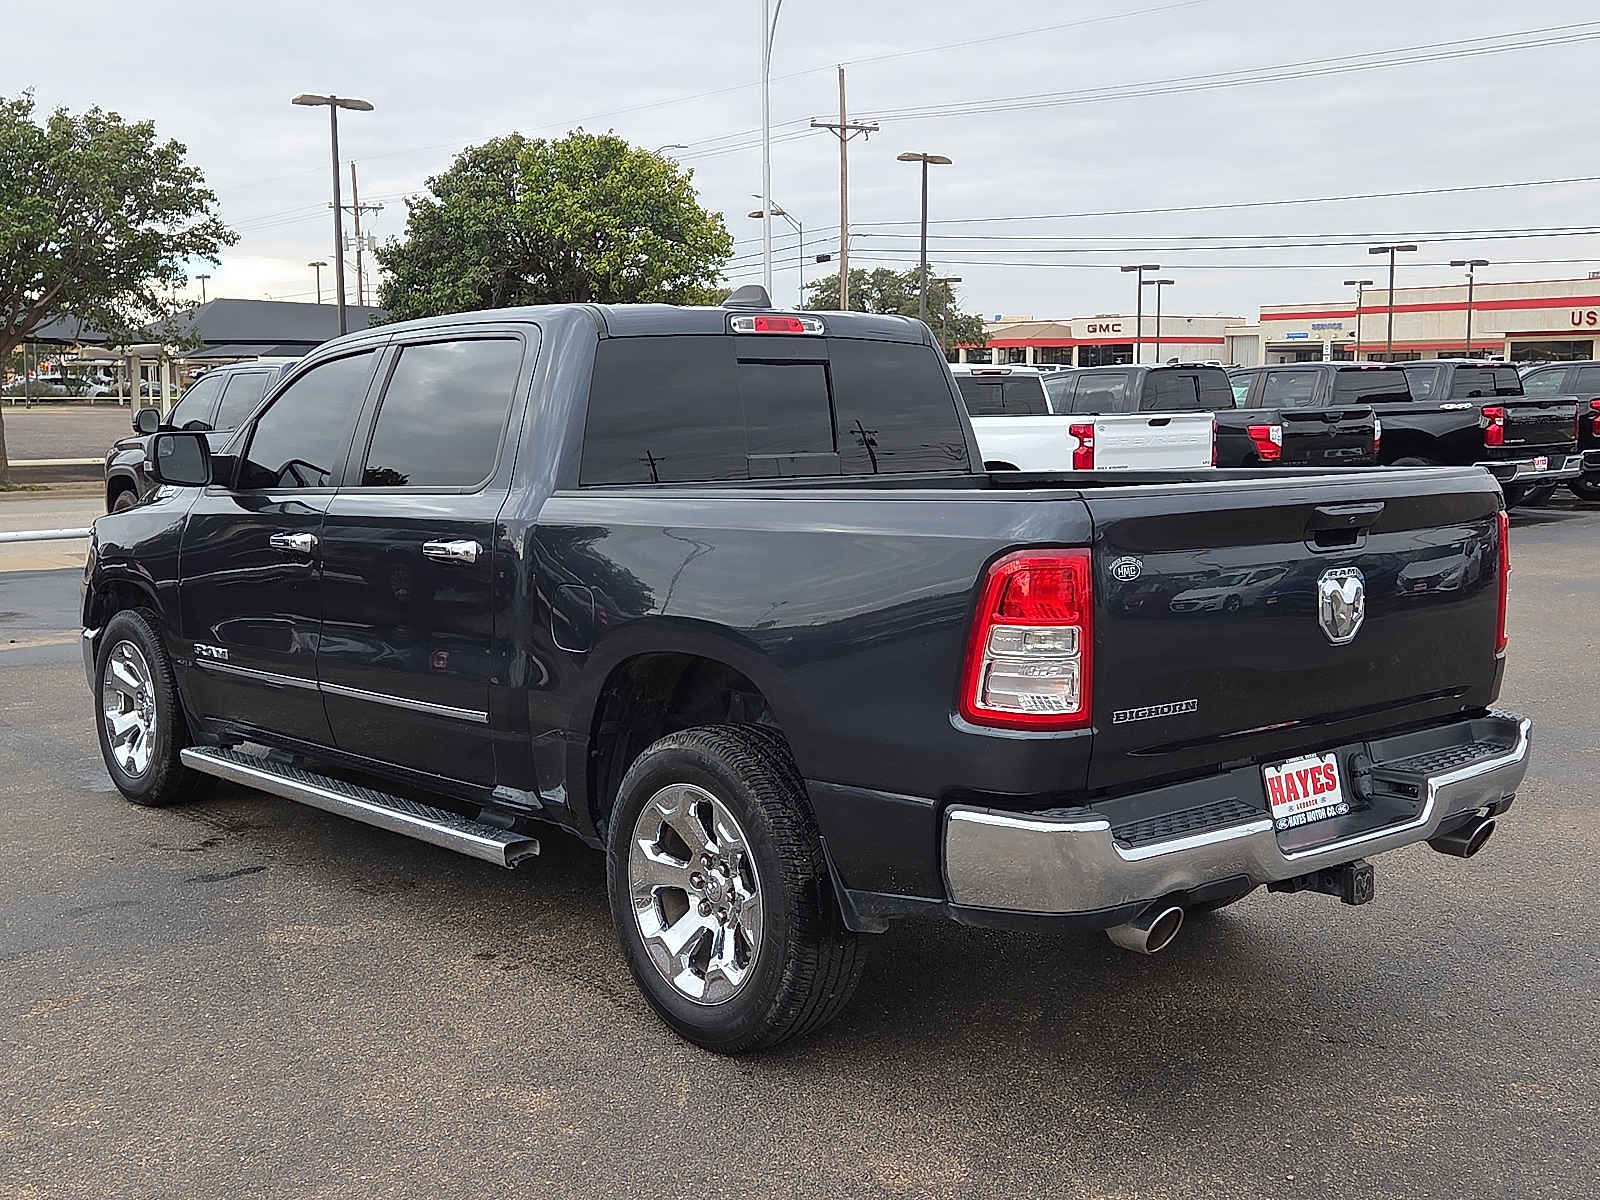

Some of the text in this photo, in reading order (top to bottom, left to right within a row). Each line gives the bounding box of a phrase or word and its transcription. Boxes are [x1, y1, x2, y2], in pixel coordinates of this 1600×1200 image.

[1087, 323, 1122, 333] GMC
[1311, 322, 1343, 331] SERVICE
[1105, 433, 1210, 448] CHEVROLET
[1117, 565, 1136, 577] HMC
[1328, 568, 1358, 577] RAM
[1112, 699, 1198, 724] BIGHORN
[1267, 763, 1337, 807] HAYES
[1288, 813, 1307, 827] HAYES
[1306, 808, 1327, 822] MOTOR
